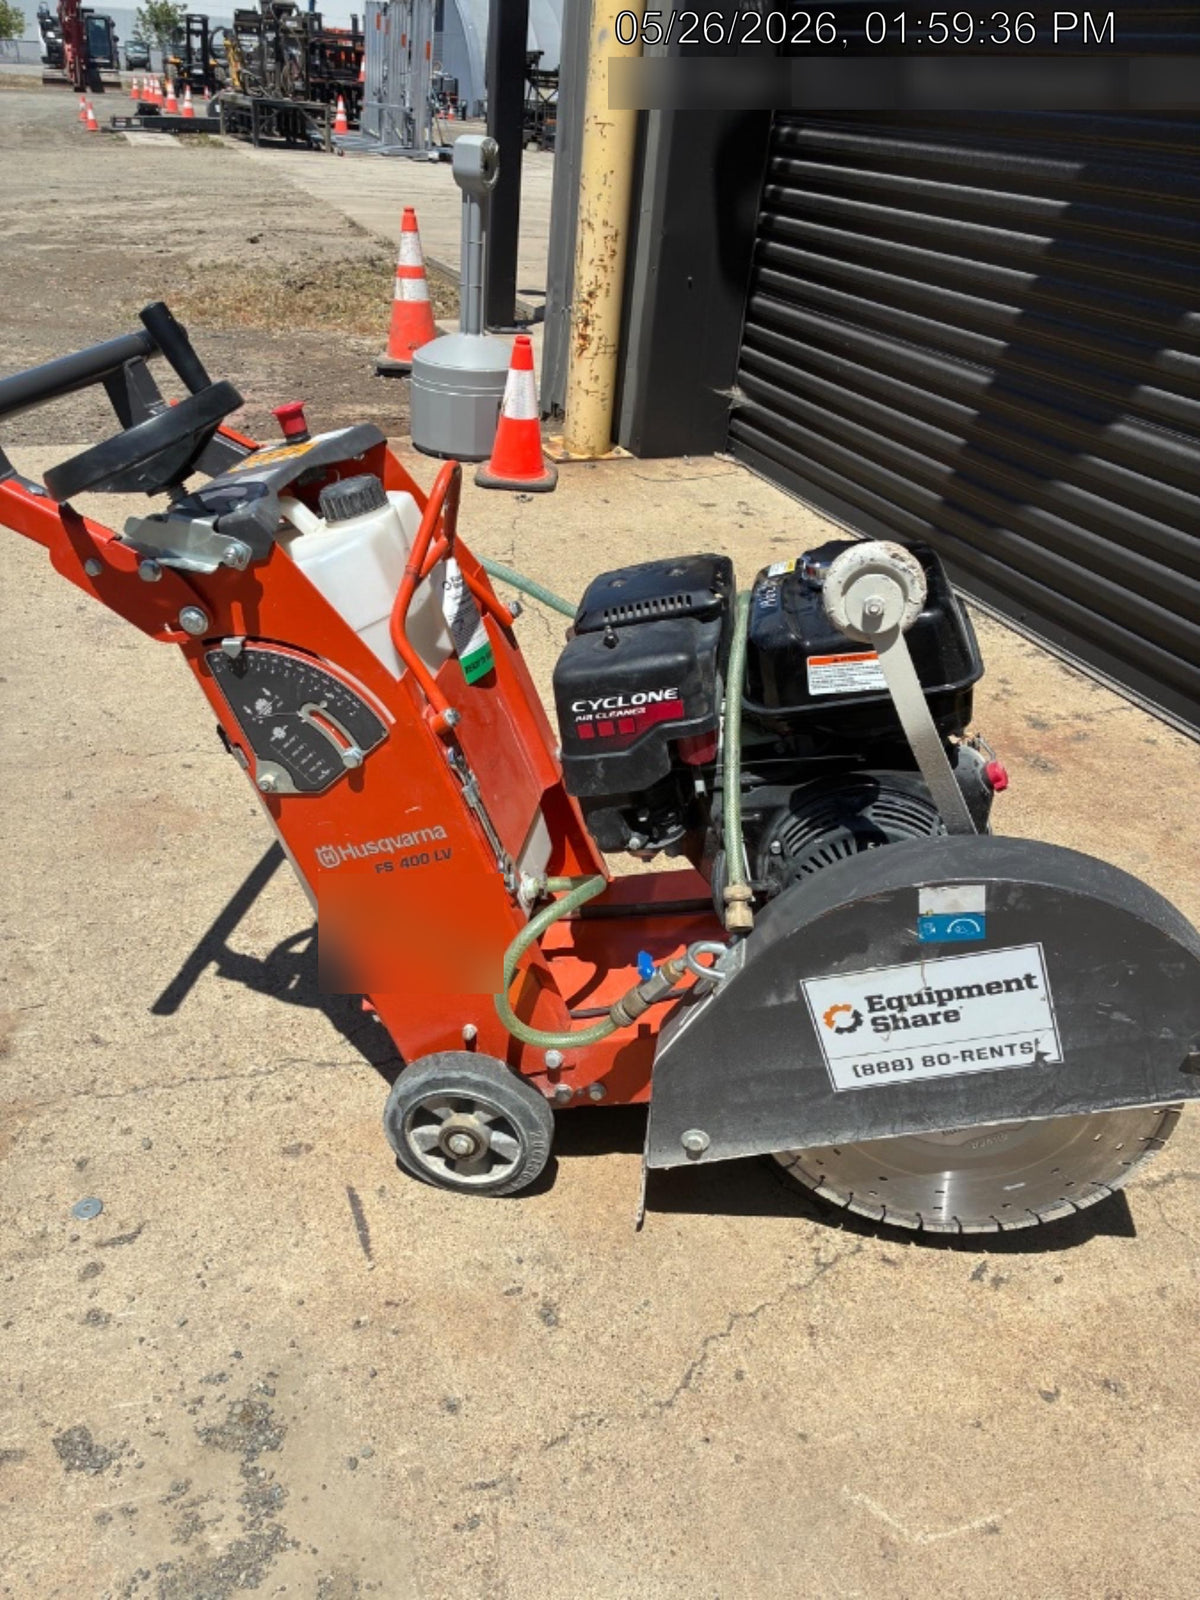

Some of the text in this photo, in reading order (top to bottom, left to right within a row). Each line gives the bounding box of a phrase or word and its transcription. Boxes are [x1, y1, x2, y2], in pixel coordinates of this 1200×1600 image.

[571, 687, 678, 713] CYCLONE
[575, 707, 646, 722] AIR CLEANER
[340, 826, 447, 861] Husqvarna
[375, 847, 452, 874] FS 400 LV
[864, 972, 1038, 1014] Equipment
[870, 1009, 961, 1033] Share
[853, 1041, 1033, 1078] (888) 80-RENTS
